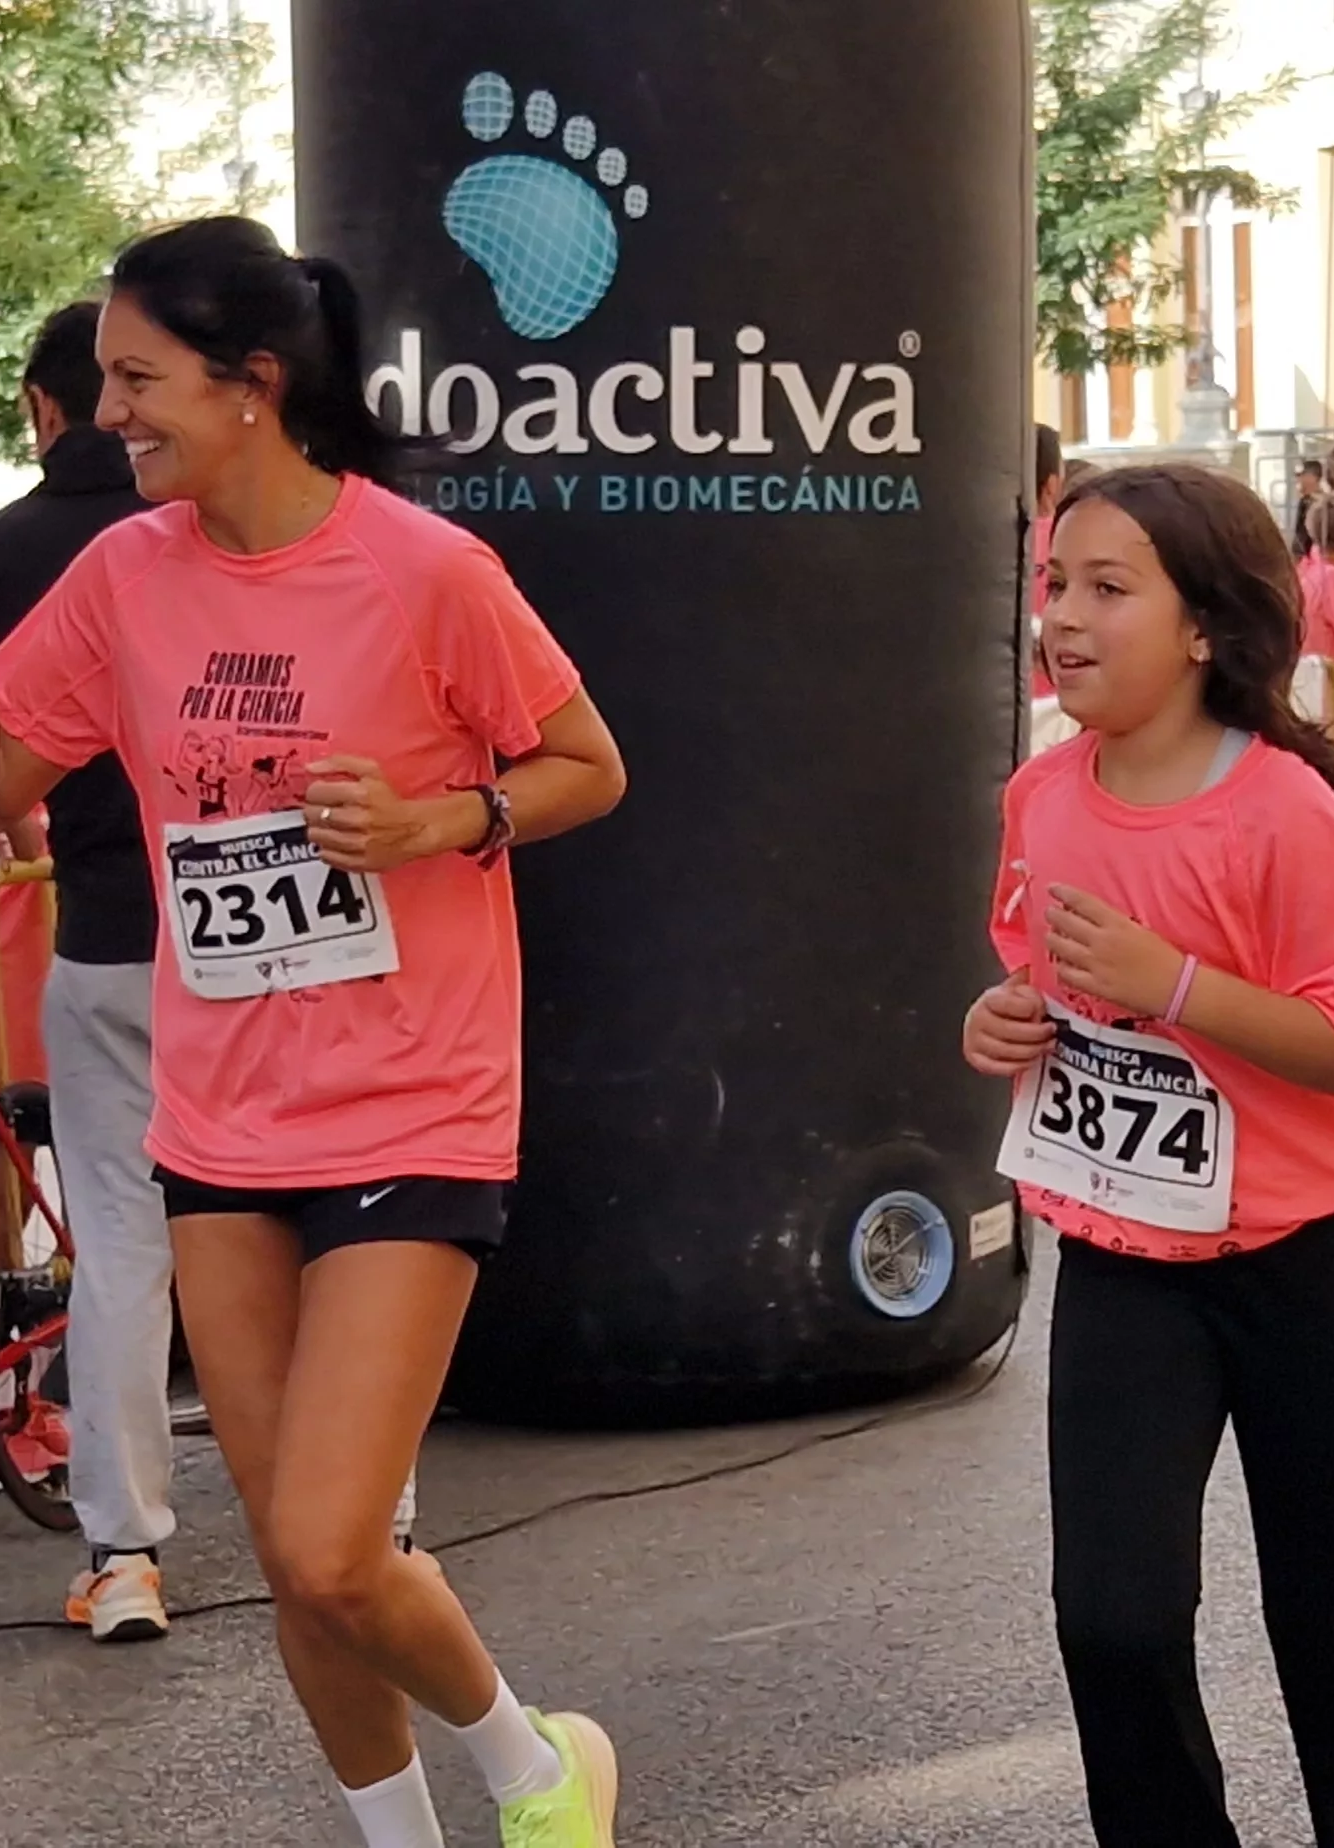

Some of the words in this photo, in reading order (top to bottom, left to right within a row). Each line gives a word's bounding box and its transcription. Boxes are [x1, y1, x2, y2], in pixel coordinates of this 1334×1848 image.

[364, 325, 922, 455] doactiva
[415, 464, 537, 512] LOGÍA
[553, 476, 582, 512] Y
[600, 465, 922, 512] BIOMECÁNICA
[204, 651, 297, 688] CORRAMOS
[178, 686, 216, 719] POR
[214, 688, 236, 721] LA
[237, 689, 305, 724] CIENCIA
[178, 856, 240, 877] CONTRA
[241, 854, 266, 871] EL
[267, 841, 322, 866] CÁNC
[219, 835, 275, 856] HUESCA
[181, 867, 366, 948] 2314
[1103, 1063, 1123, 1083] EL
[1040, 1065, 1209, 1175] 3874
